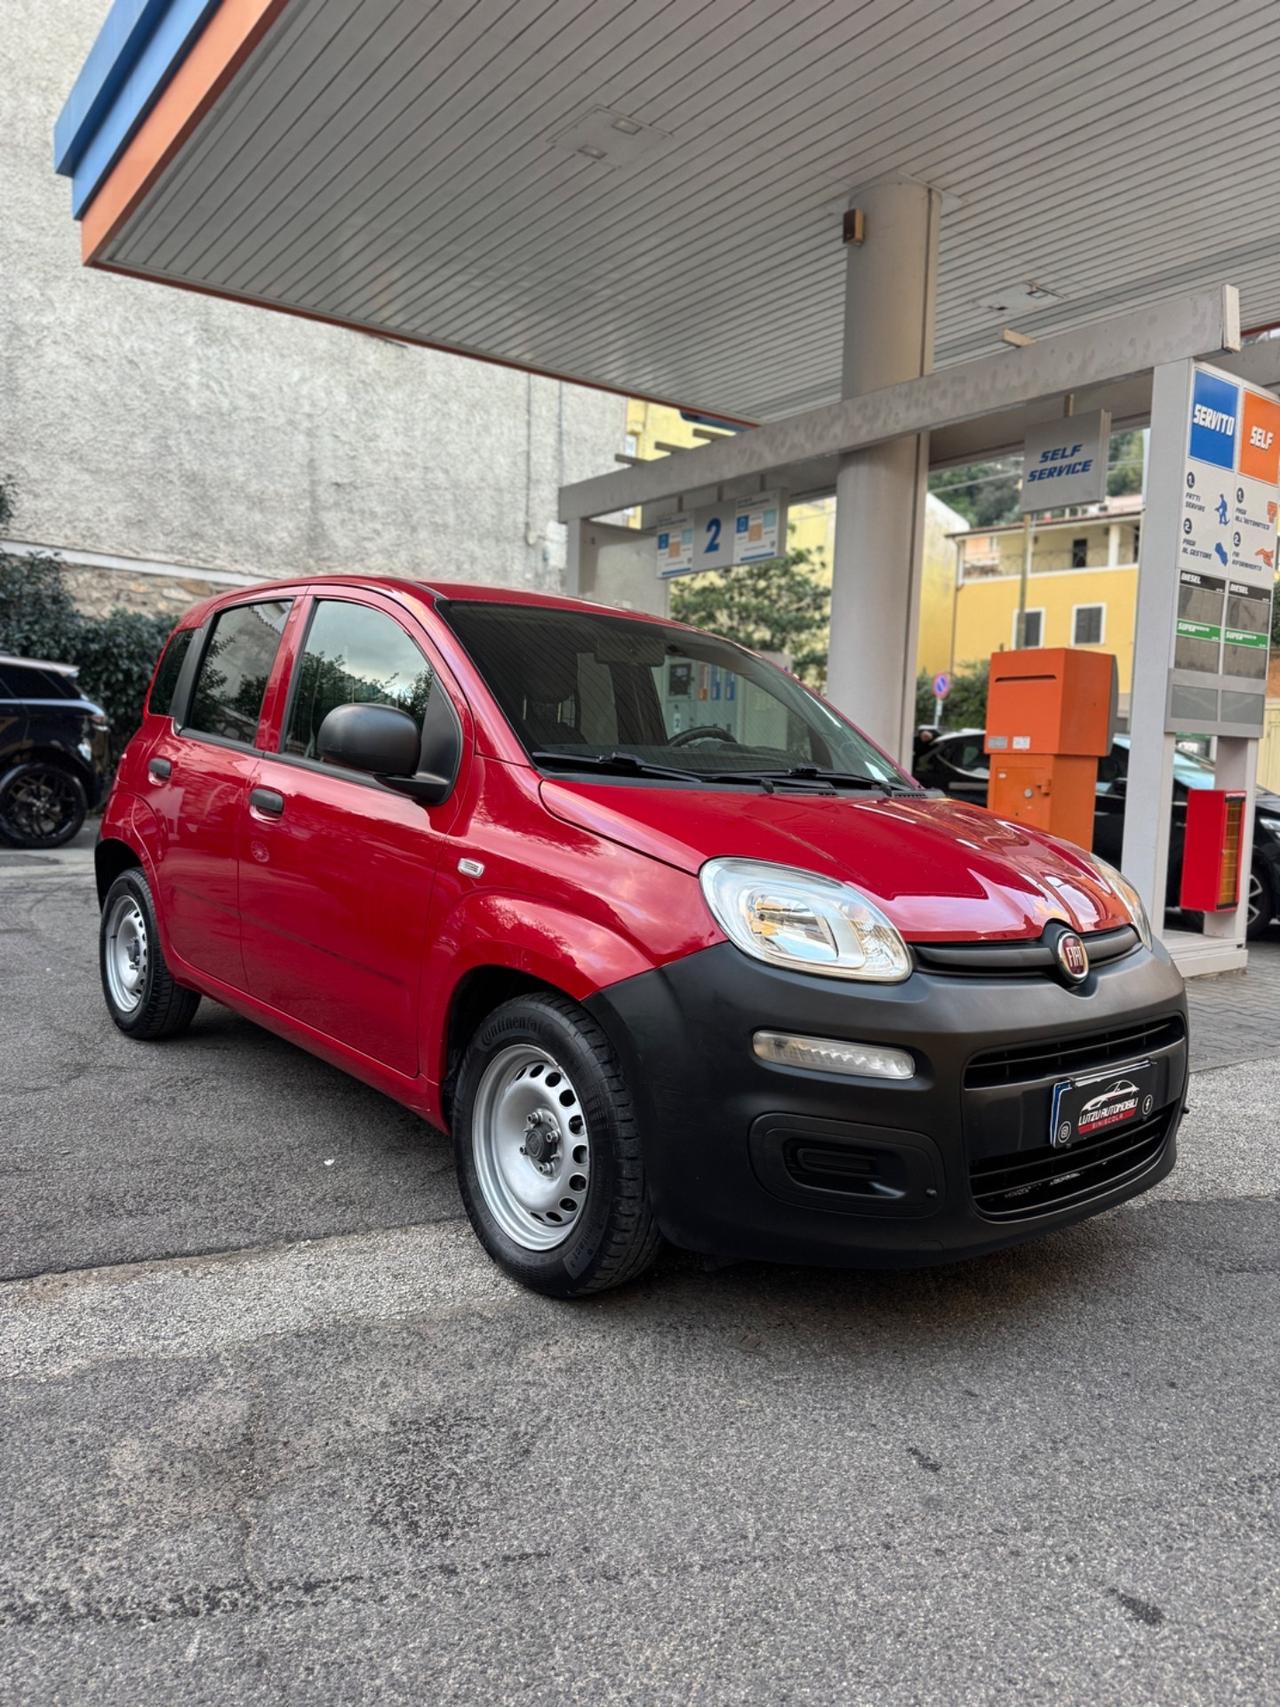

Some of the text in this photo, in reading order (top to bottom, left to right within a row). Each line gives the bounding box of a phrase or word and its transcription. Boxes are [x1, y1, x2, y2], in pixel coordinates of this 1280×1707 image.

[1193, 403, 1235, 436] SERVITO
[1249, 425, 1274, 450] SELF
[1039, 444, 1083, 463] SELF
[1027, 459, 1093, 482] SERVICE
[703, 517, 722, 554] 2
[1181, 572, 1201, 584] DIESEL
[1230, 583, 1249, 595] DIESEL
[1178, 622, 1196, 632] SUPER
[1226, 631, 1243, 641] SUPER
[1066, 946, 1083, 967] FIAT
[1078, 1097, 1139, 1126] LUTZU AUTOMOBILI
